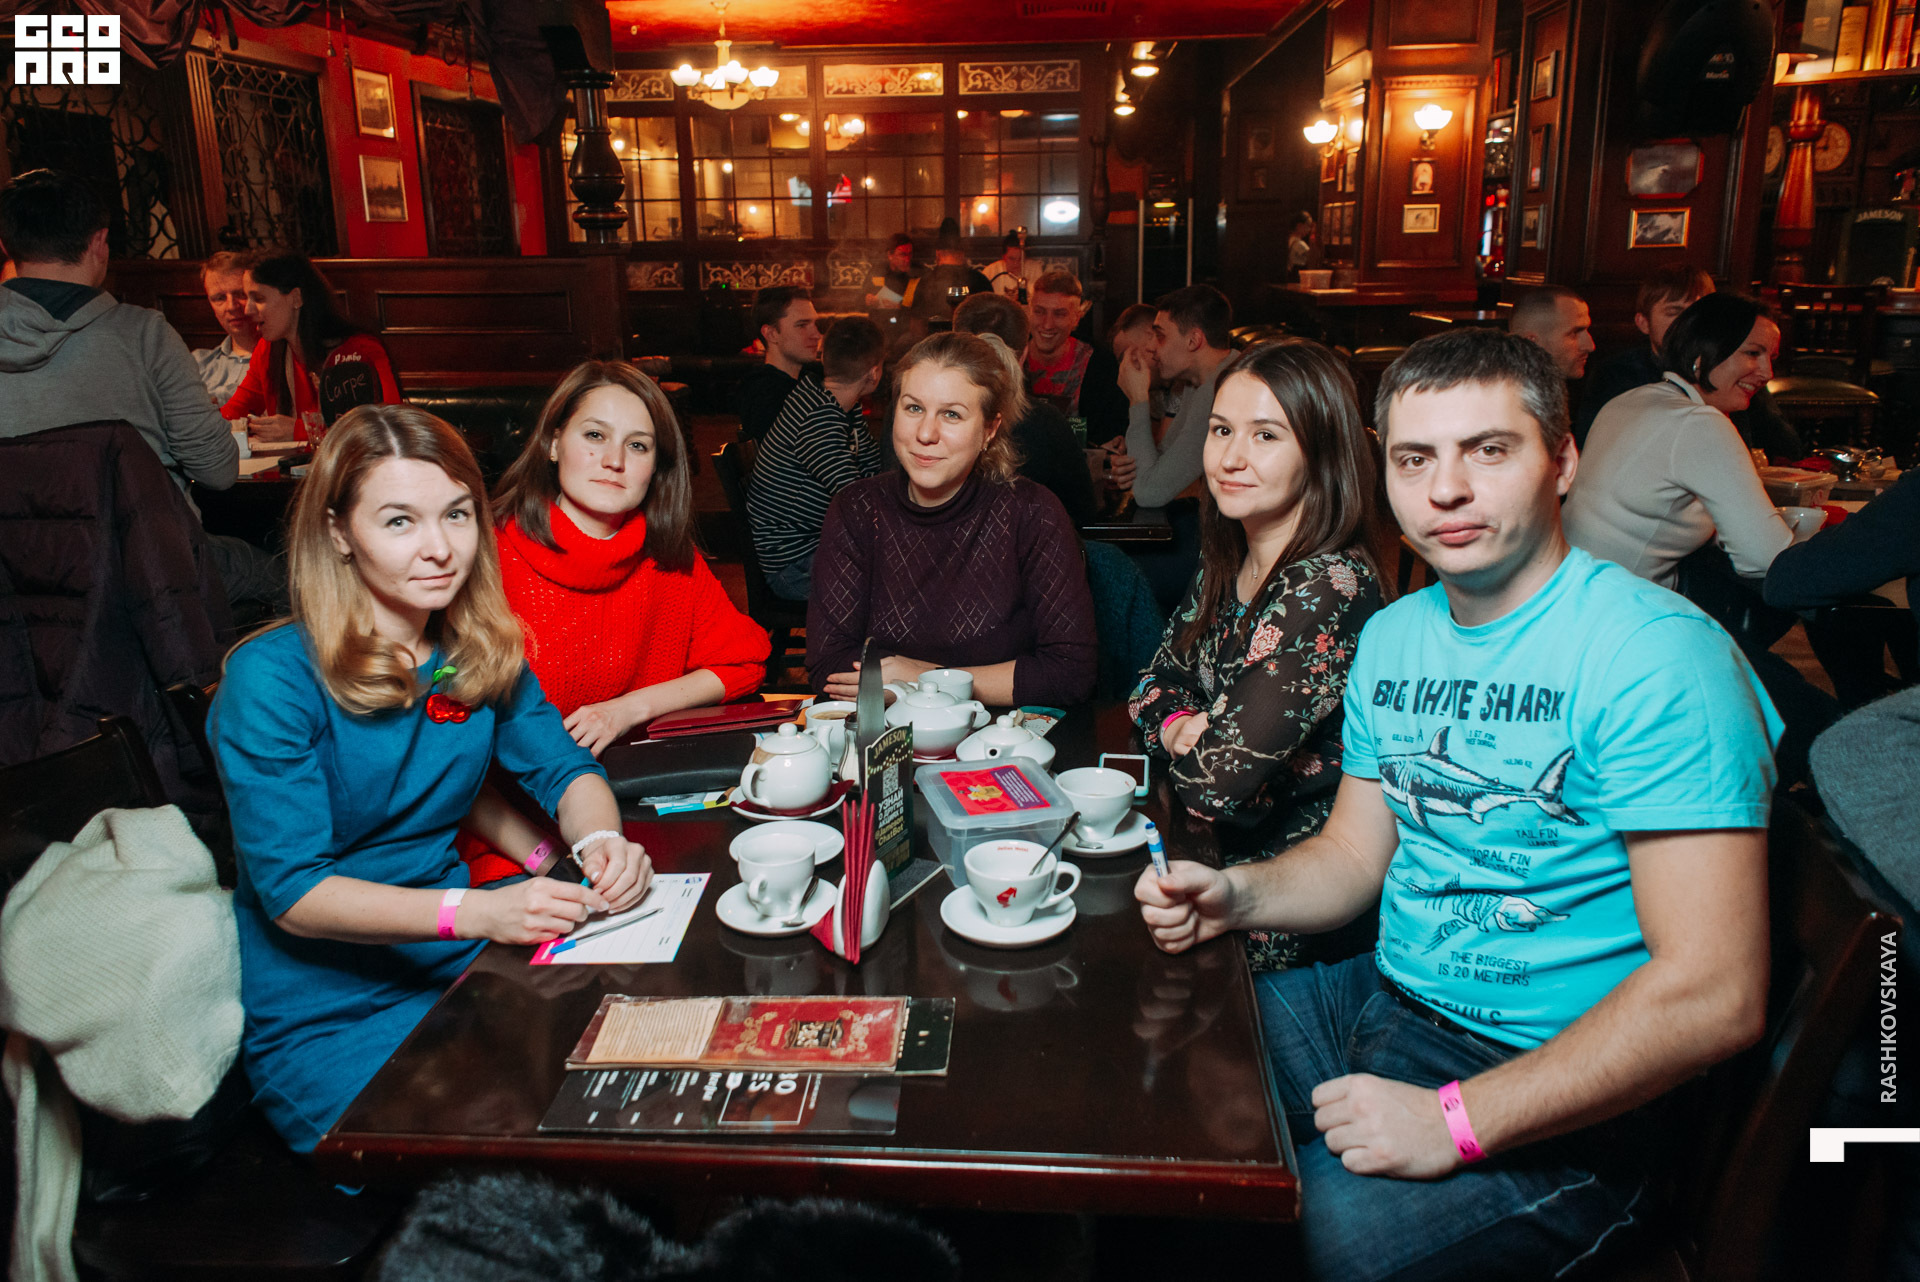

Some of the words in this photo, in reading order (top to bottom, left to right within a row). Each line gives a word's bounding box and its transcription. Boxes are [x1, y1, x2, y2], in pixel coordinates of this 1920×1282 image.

[1855, 209, 1904, 223] JAMESON
[325, 373, 367, 402] Carpe
[1373, 679, 1409, 712] BIG
[1480, 682, 1566, 722] SHARK
[873, 729, 908, 760] JAMESON
[878, 786, 904, 814] УЗНАЙ
[883, 799, 904, 819] ДРУГИХ
[878, 823, 904, 847] ChatBot
[1515, 829, 1538, 839] TAIL
[1539, 828, 1559, 839] FIN
[1509, 852, 1532, 867] FIN
[1450, 951, 1473, 965] THE
[1475, 953, 1531, 973] BIGGEST
[1438, 963, 1450, 976] IS
[1454, 966, 1470, 979] 20
[1474, 970, 1531, 987] METERS
